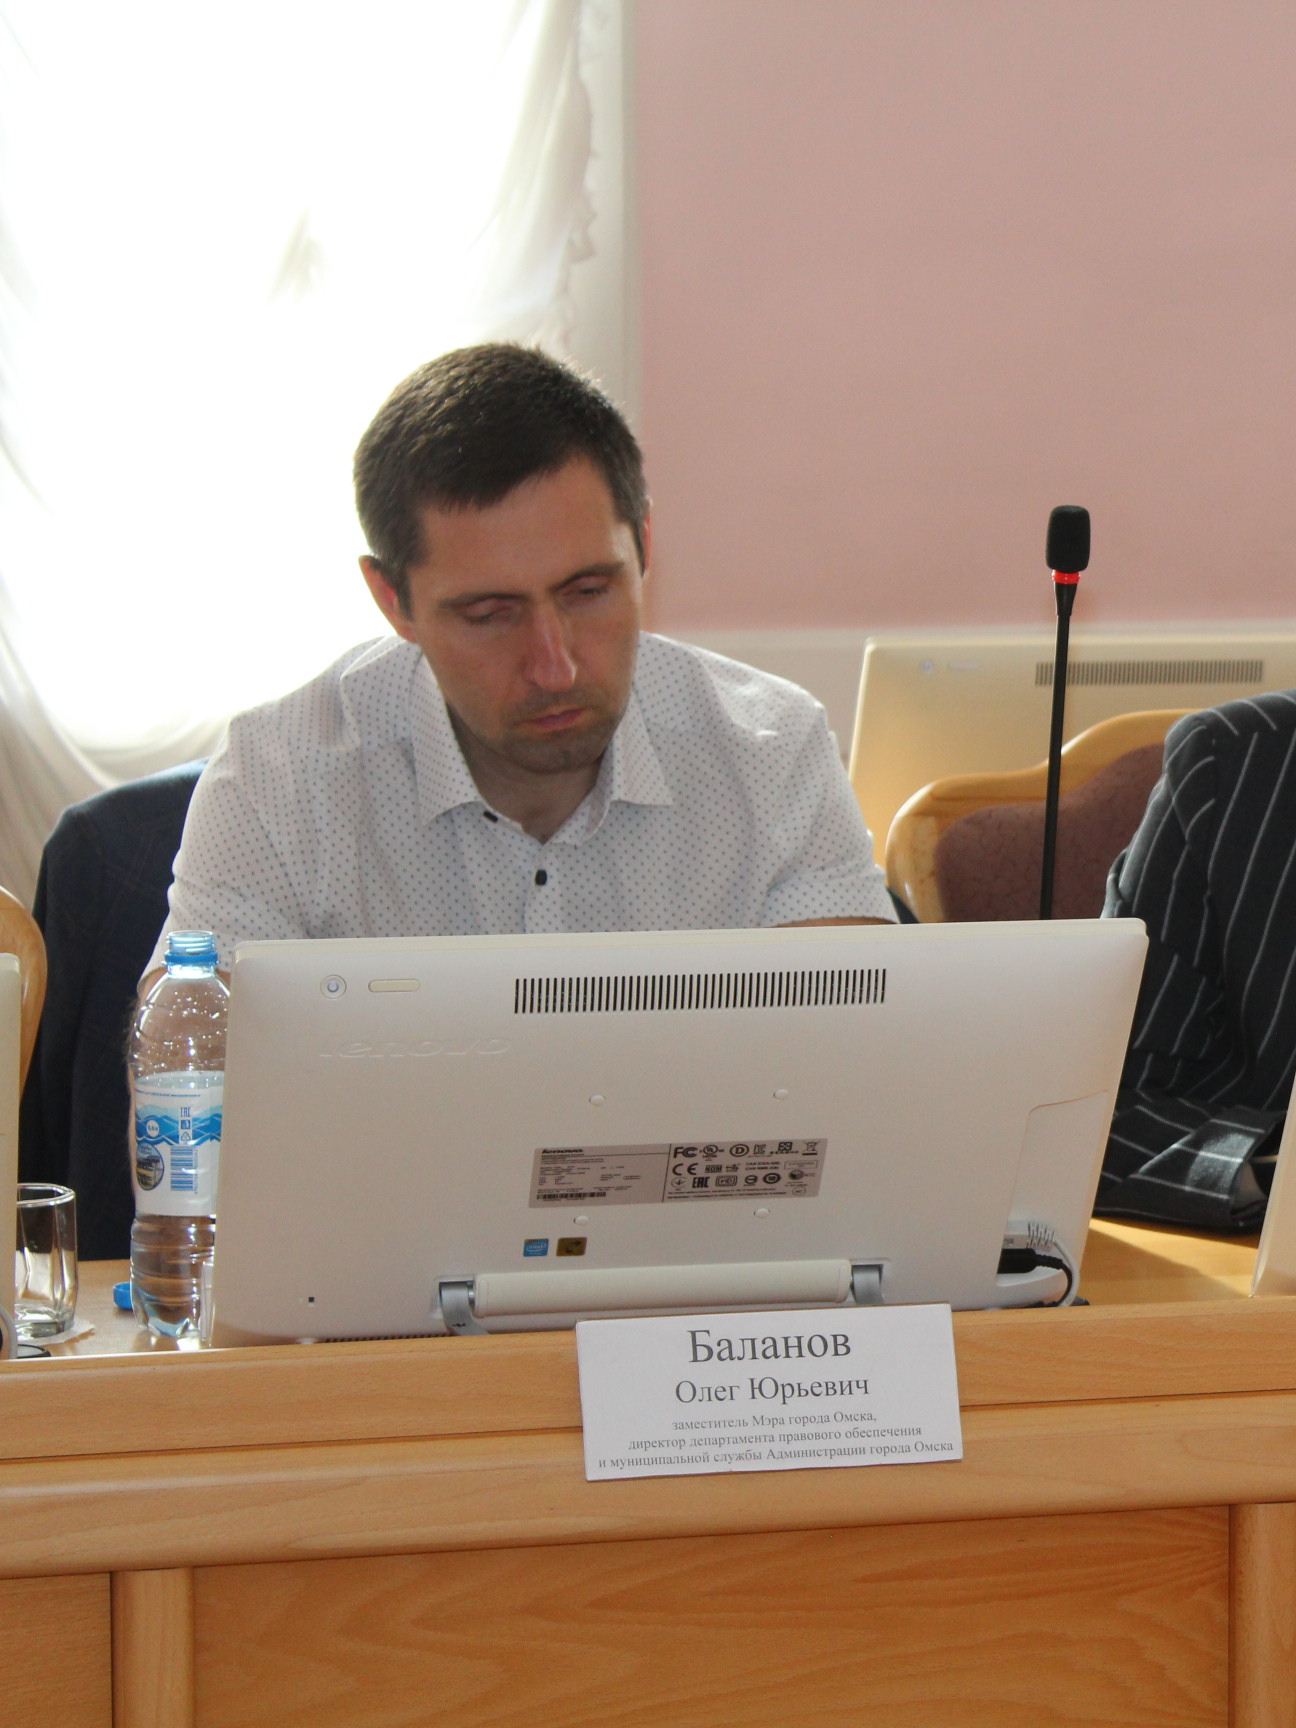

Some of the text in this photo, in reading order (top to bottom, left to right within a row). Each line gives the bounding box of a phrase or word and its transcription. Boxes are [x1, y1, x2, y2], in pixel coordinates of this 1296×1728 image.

[686, 1329, 851, 1363] Баланов
[675, 1376, 870, 1405] Олег Юрьевич
[671, 1410, 877, 1431] заместитель Мэра города Омска,
[628, 1426, 922, 1452] директор департамента правового обеспечения
[598, 1440, 954, 1470] и муниципальной службы Администрации города Омска
